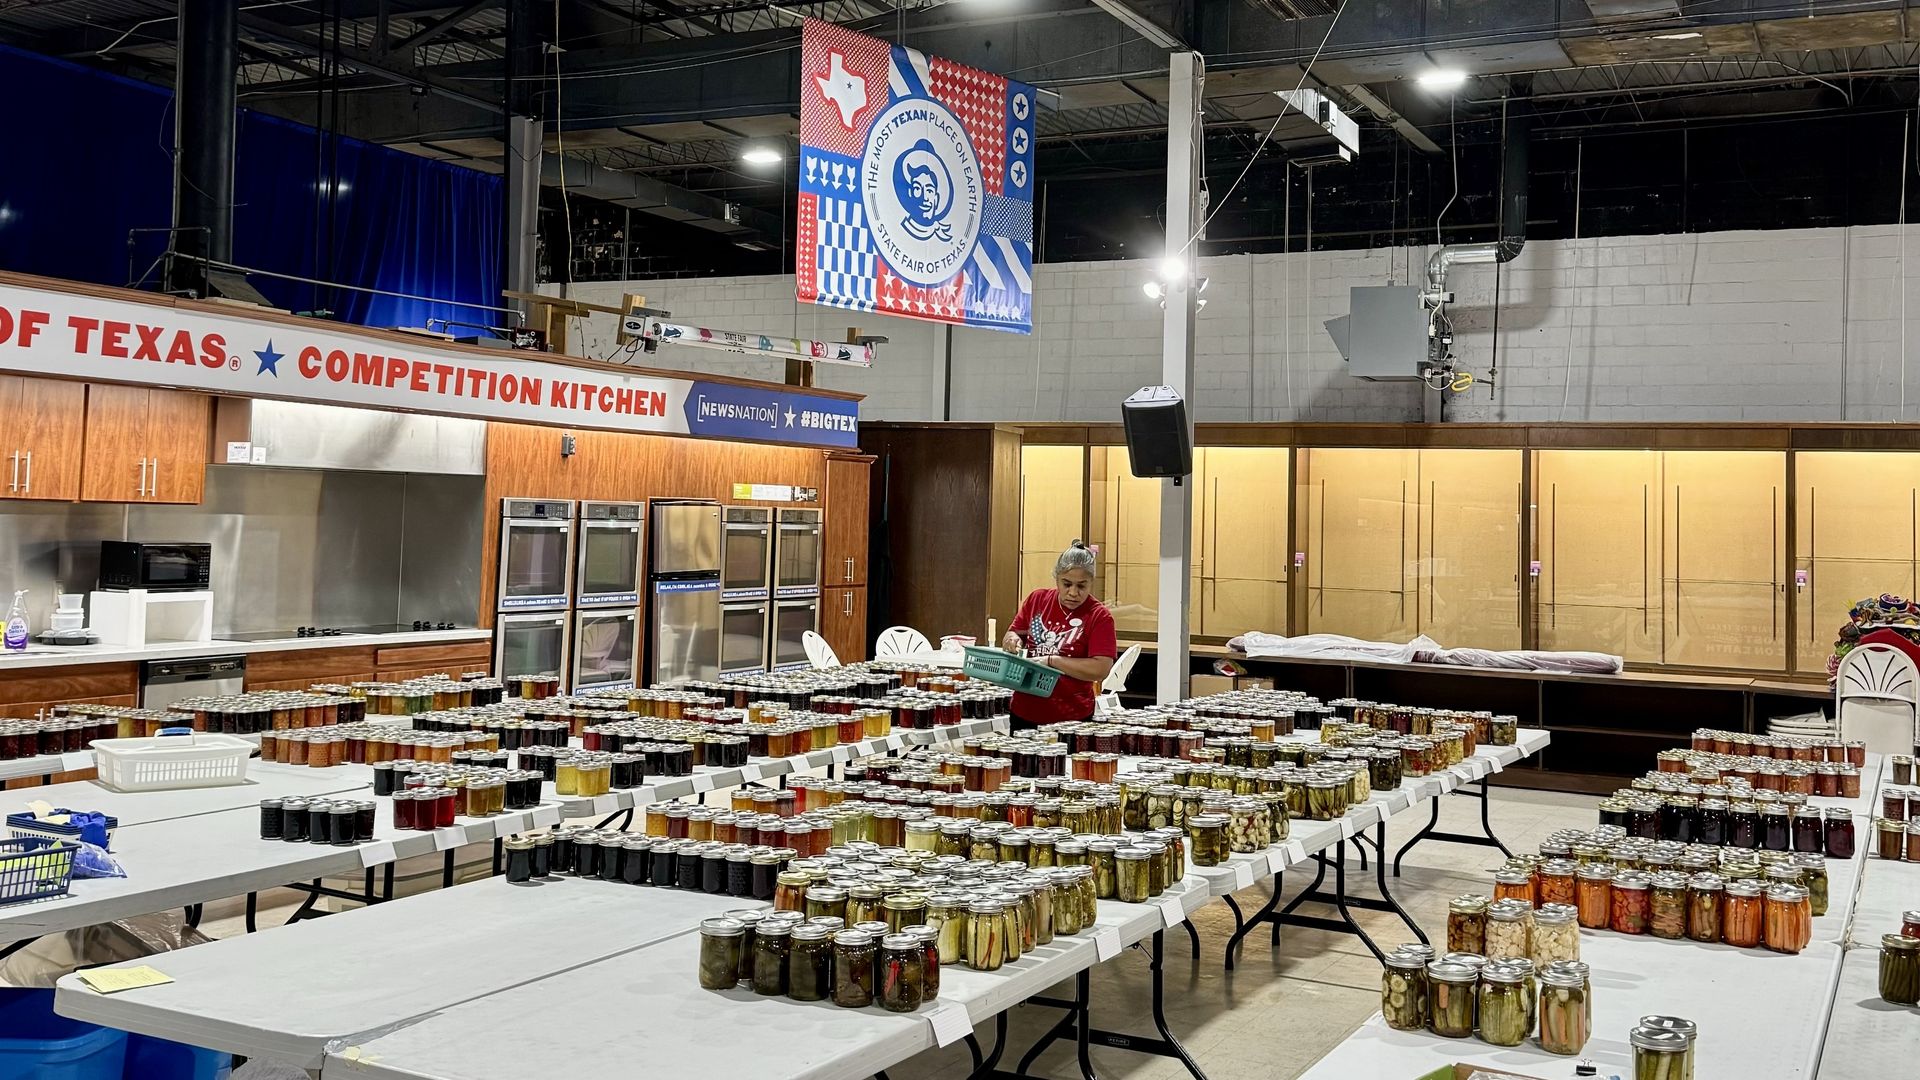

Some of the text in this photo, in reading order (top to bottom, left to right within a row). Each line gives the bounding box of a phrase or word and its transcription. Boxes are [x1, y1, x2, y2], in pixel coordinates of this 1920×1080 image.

[868, 109, 977, 213] THE MOST TEXAN PLACE ON EARTH
[878, 223, 966, 274] STATE FAIR OF TEXAS
[299, 347, 543, 406] COMPETITION
[551, 381, 667, 417] KITCHEN
[801, 410, 857, 432] #BIGTEX
